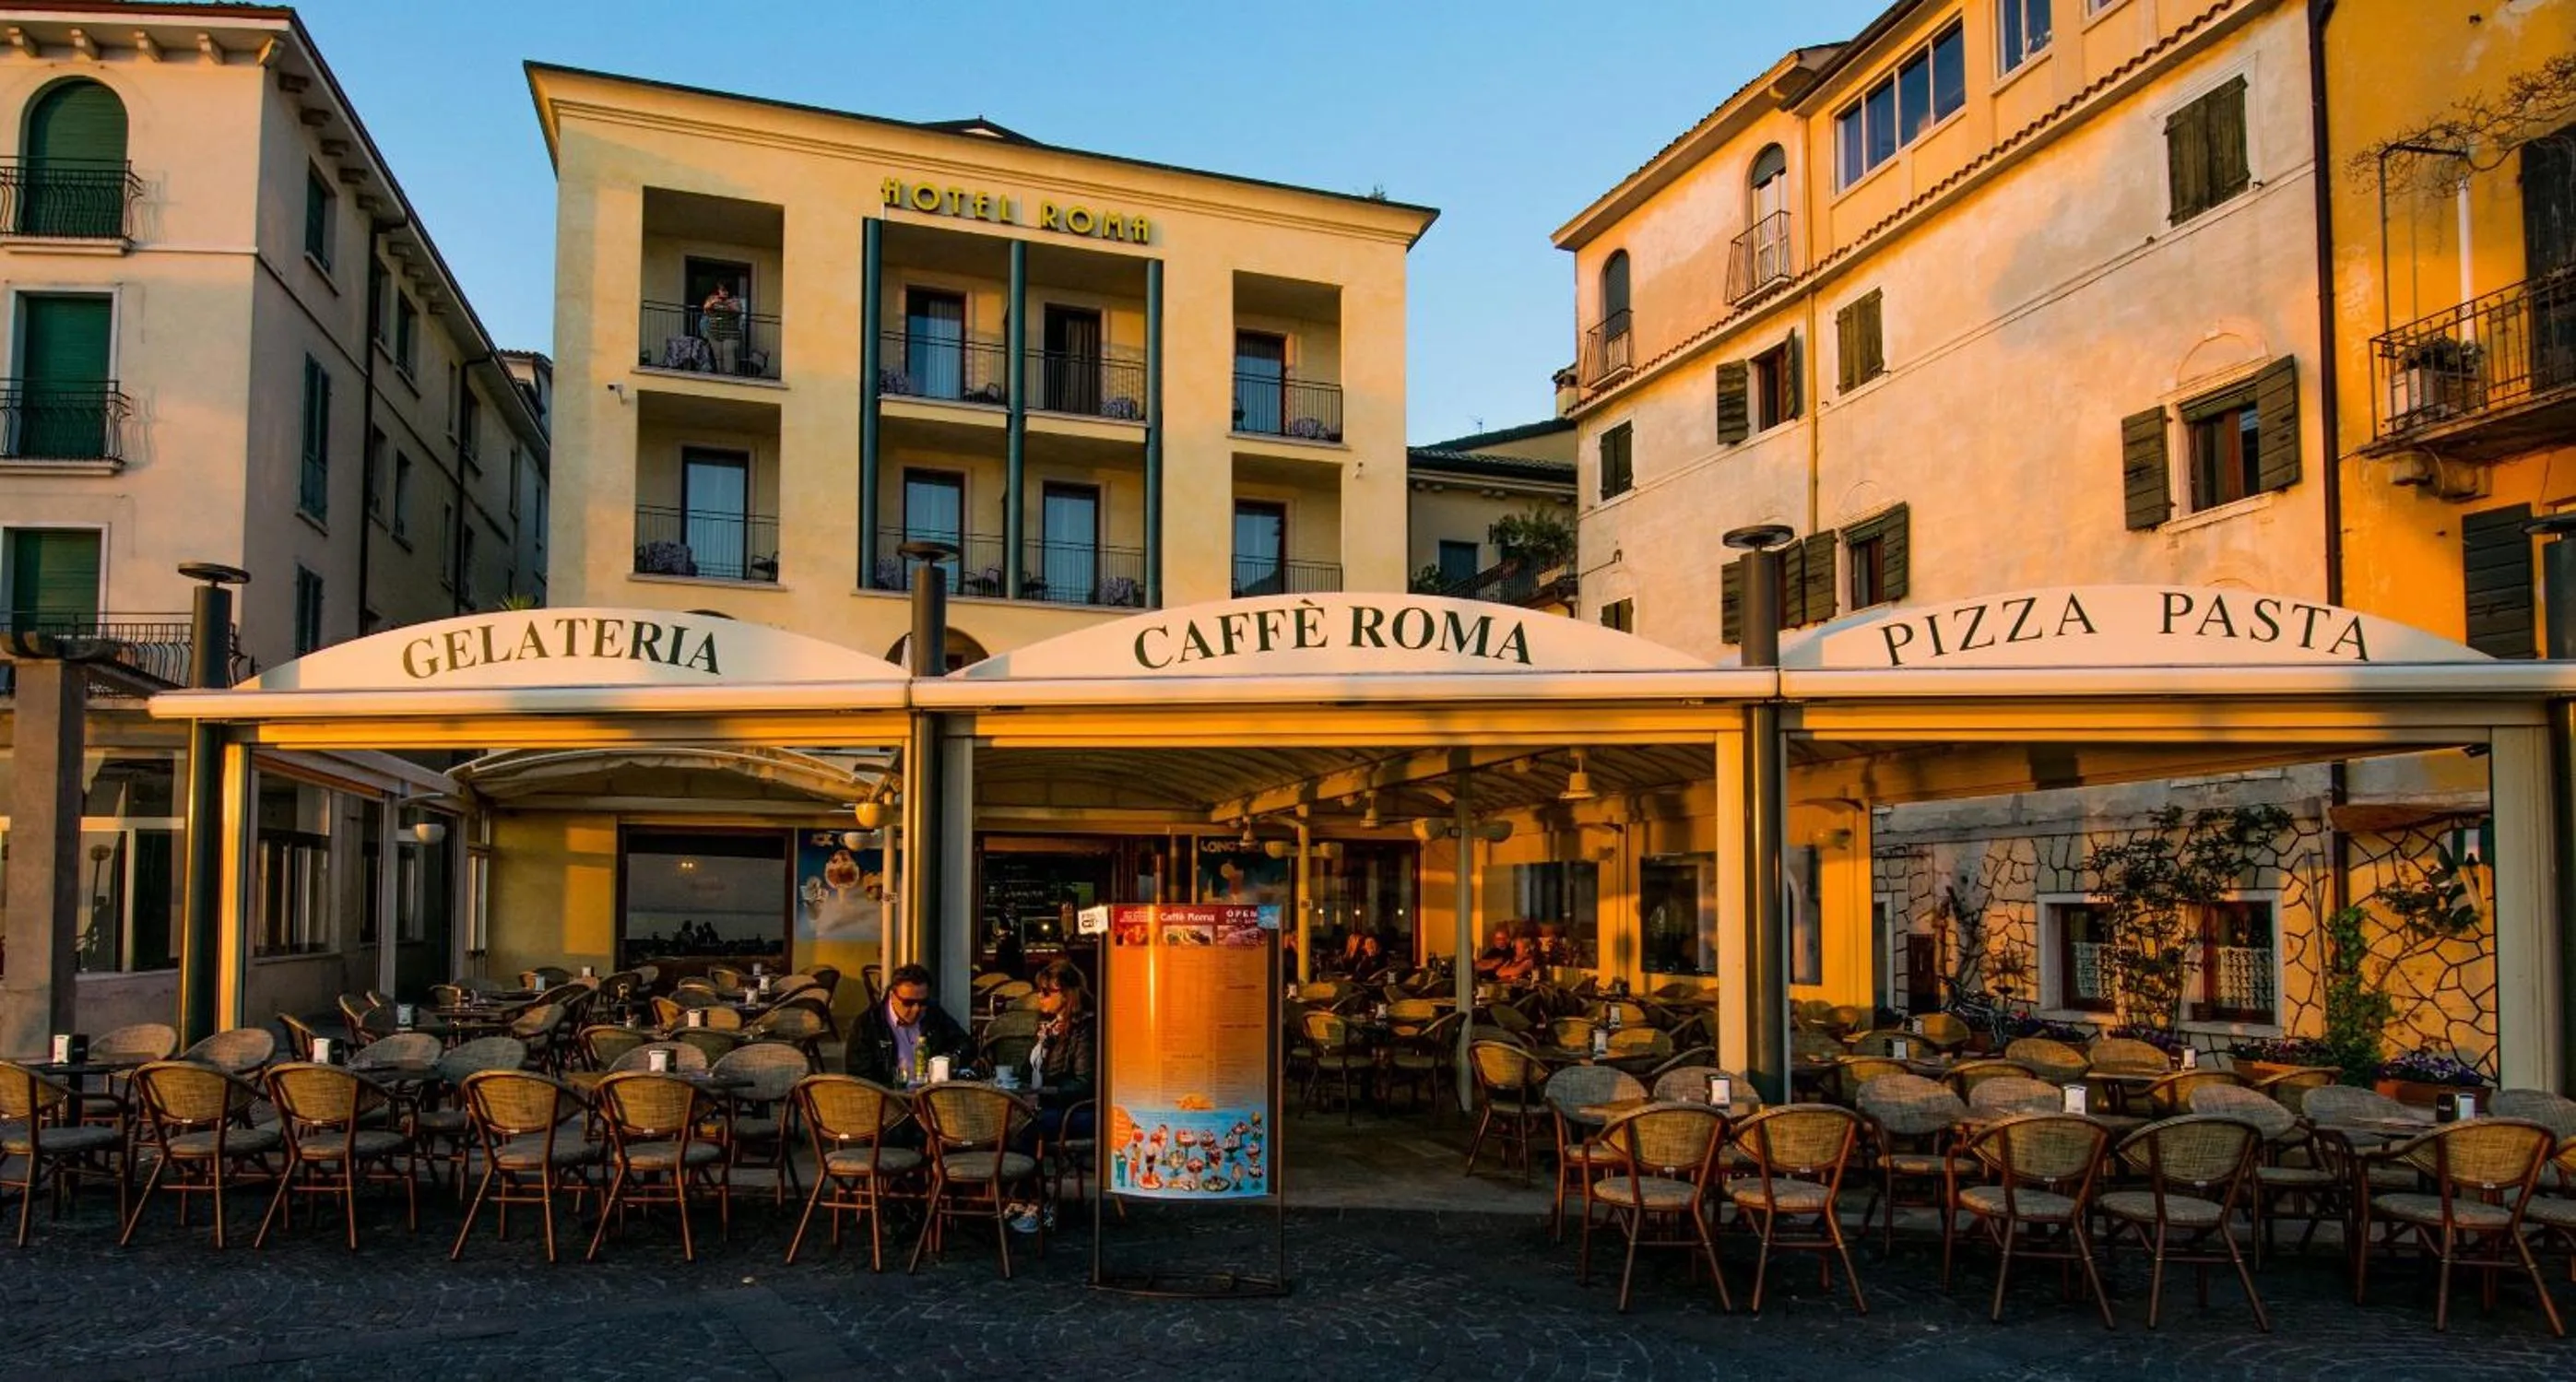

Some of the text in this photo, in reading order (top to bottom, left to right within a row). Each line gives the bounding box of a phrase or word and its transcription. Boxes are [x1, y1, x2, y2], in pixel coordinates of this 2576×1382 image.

[880, 176, 1150, 244] HOTEL ROMA
[402, 618, 722, 679] GELATERIA
[1134, 598, 1534, 669] CAFFÈ ROMA
[1879, 591, 2371, 667] PIZZA PASTA
[1188, 913, 1215, 922] Roma
